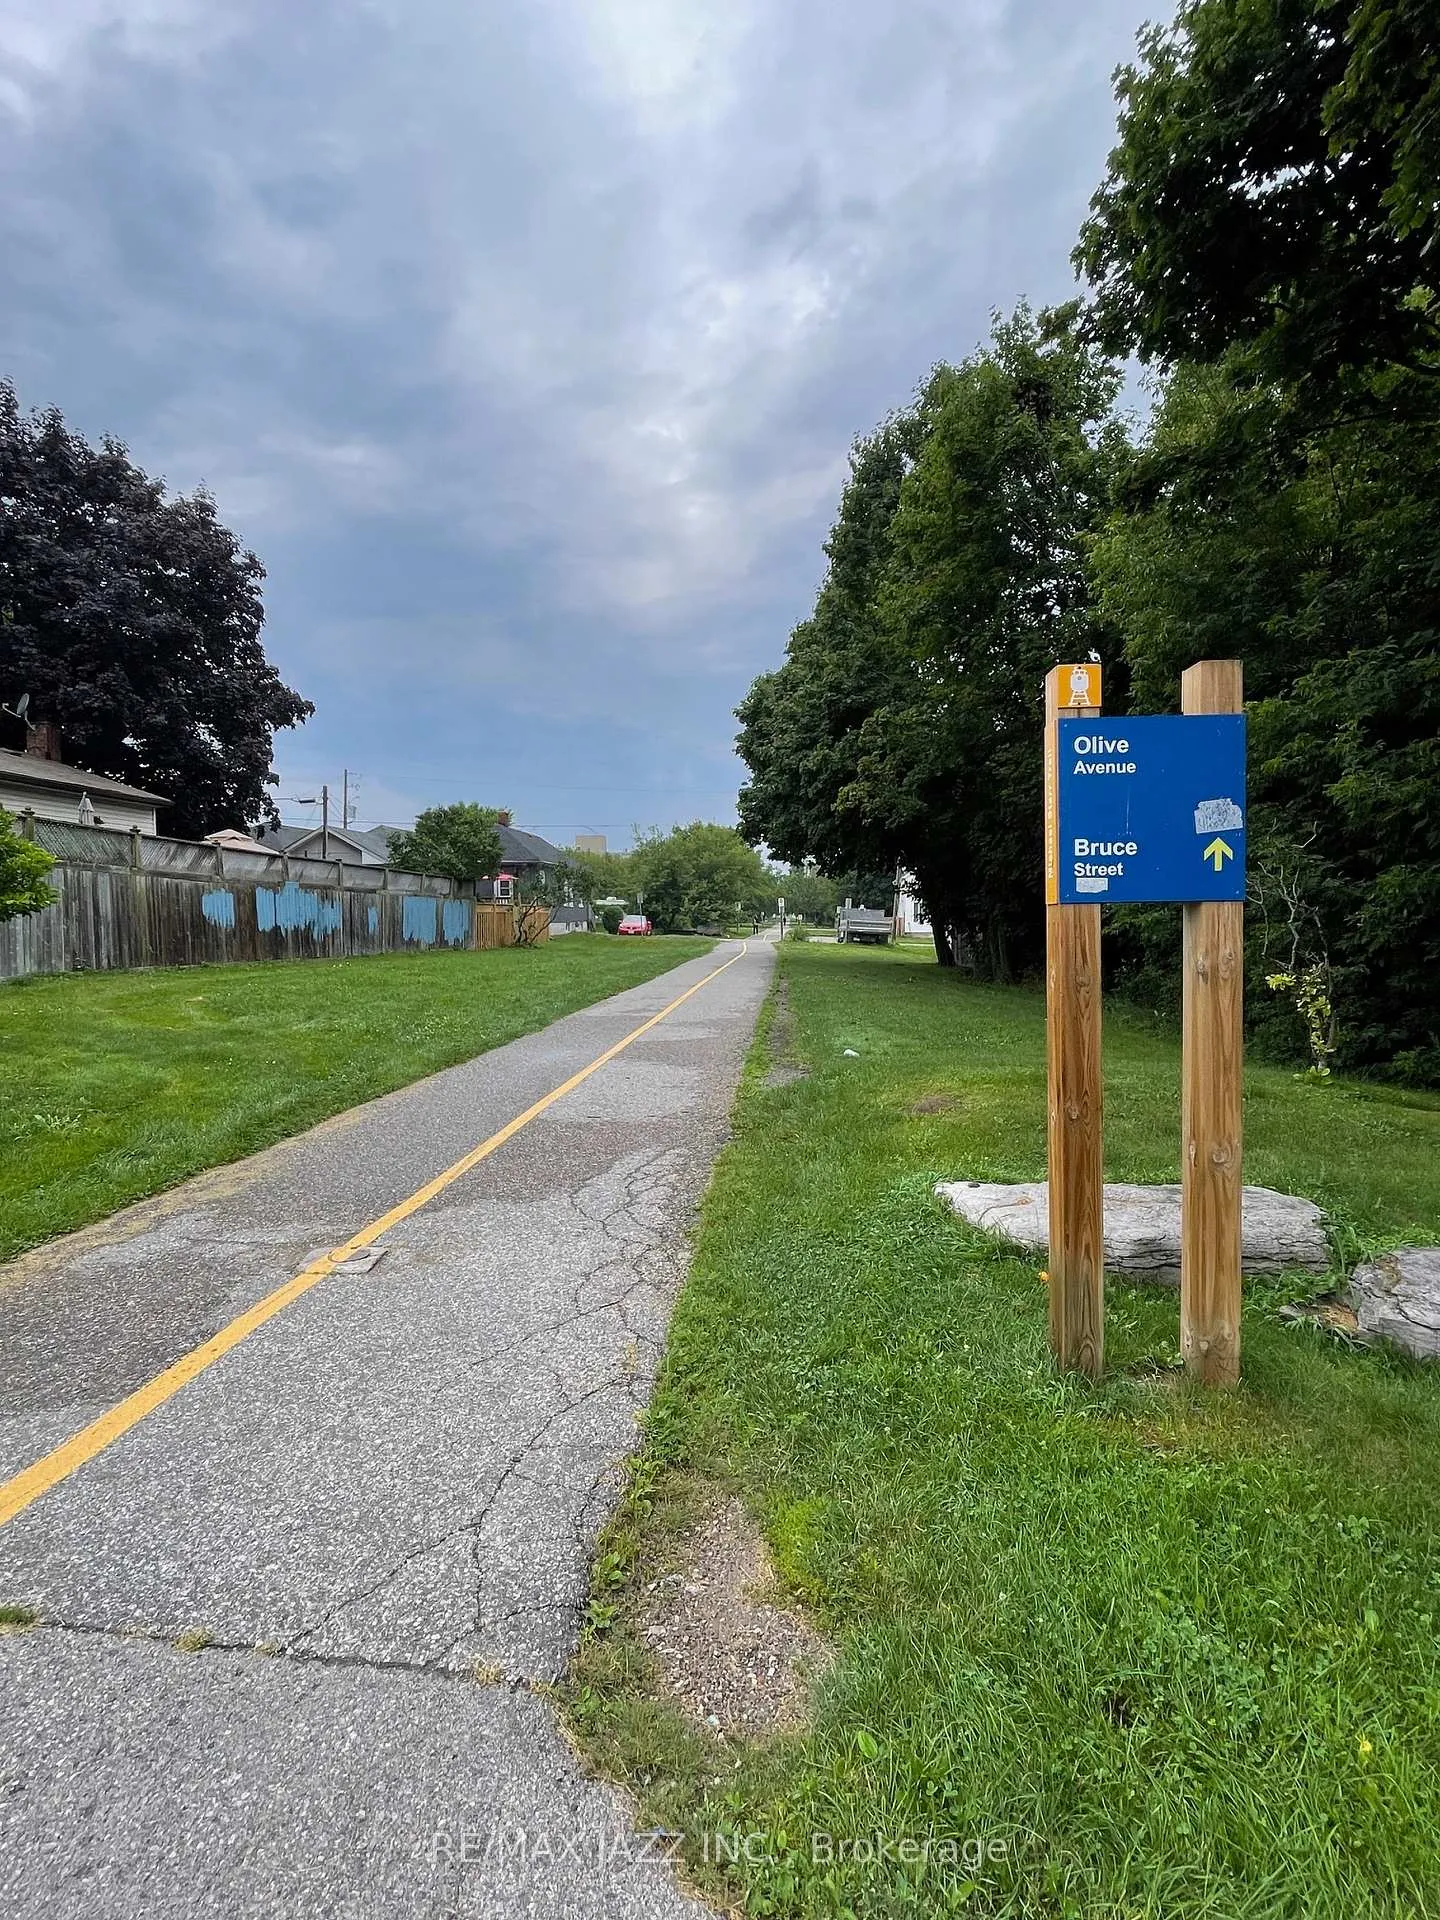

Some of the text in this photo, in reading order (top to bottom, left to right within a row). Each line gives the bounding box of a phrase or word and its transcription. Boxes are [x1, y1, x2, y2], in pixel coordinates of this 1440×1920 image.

[1075, 736, 1128, 754] Olive
[1074, 761, 1136, 774] Avenue
[1075, 839, 1137, 856] Bruce
[1075, 863, 1123, 876] Street
